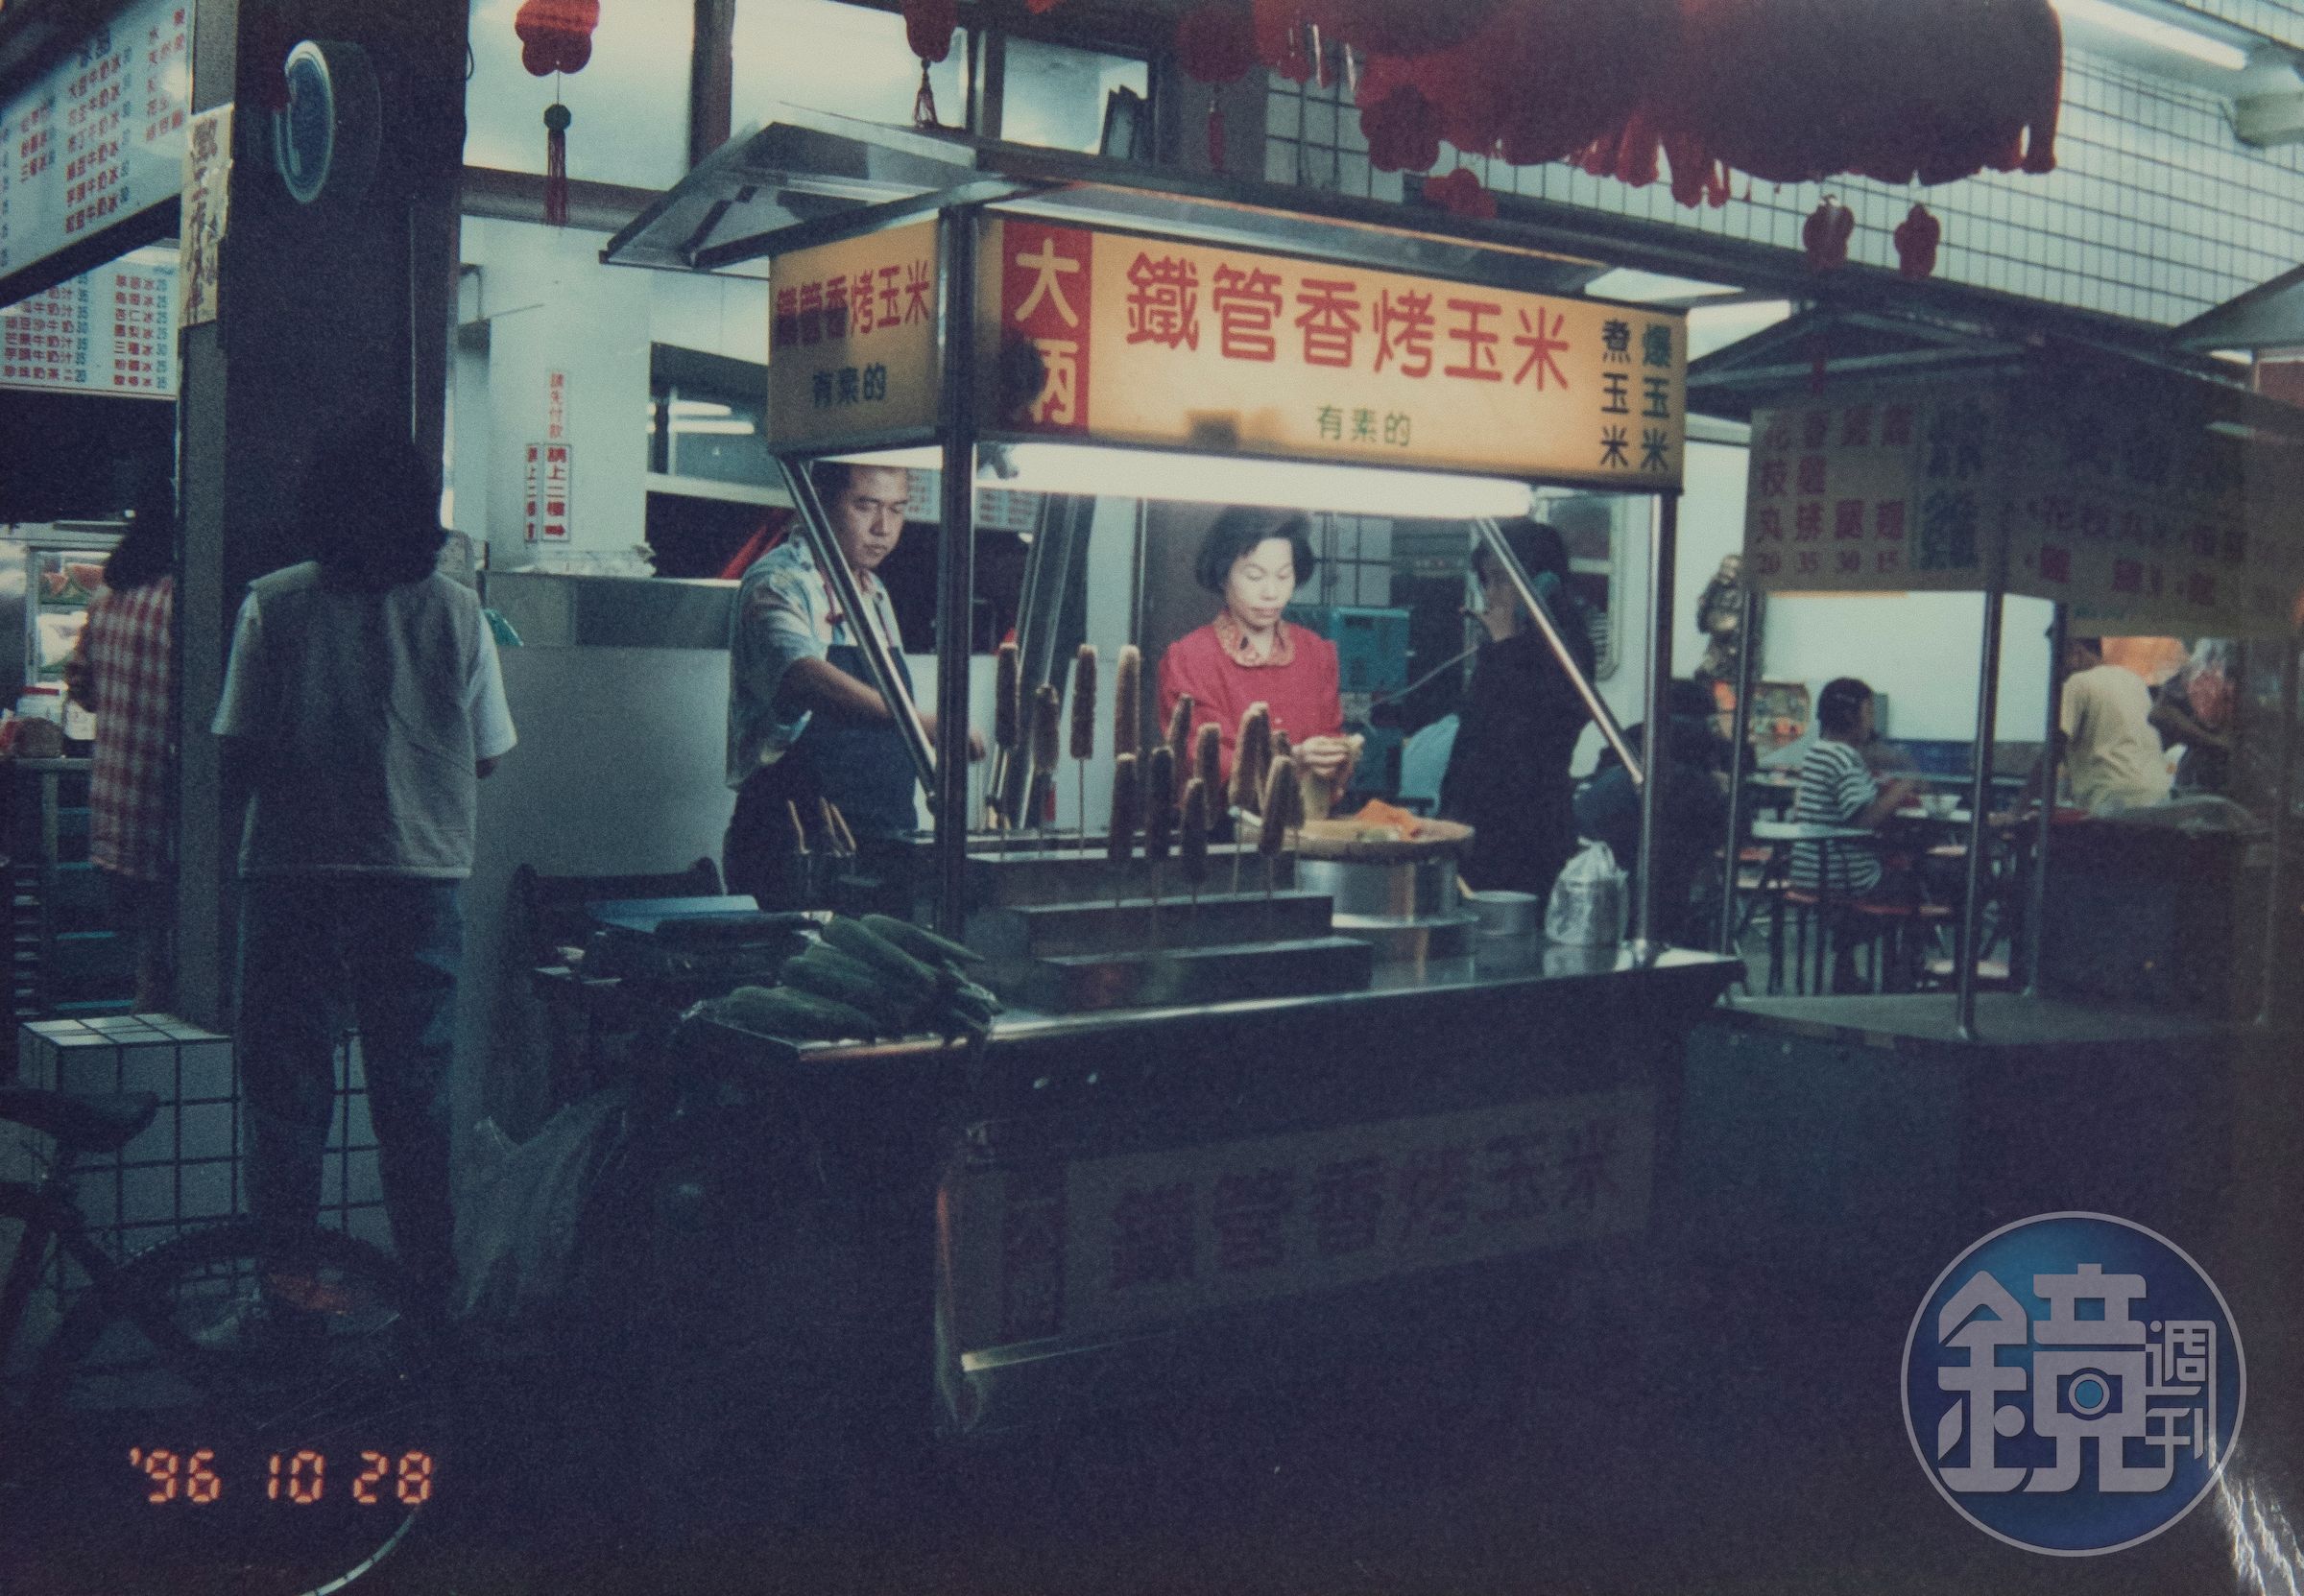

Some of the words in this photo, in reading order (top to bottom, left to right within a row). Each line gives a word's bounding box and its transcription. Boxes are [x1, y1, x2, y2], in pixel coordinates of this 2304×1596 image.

[1126, 251, 1571, 392] 鐵管香烤玉米
[813, 362, 888, 406] 有素的
[1316, 404, 1412, 448] 有素的
[1601, 318, 1631, 469] 煮玉米
